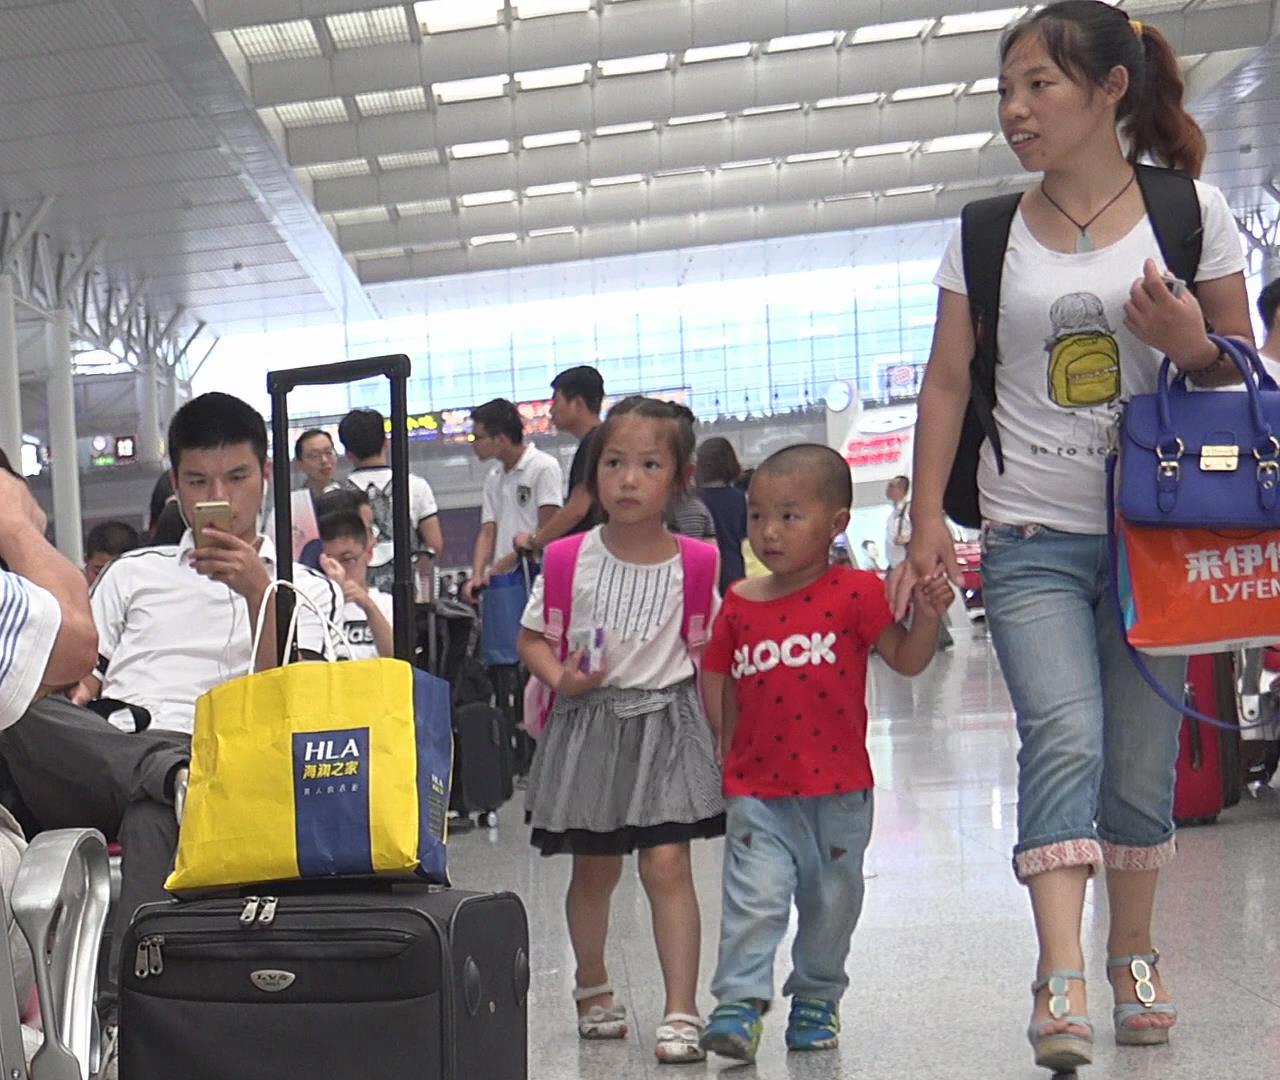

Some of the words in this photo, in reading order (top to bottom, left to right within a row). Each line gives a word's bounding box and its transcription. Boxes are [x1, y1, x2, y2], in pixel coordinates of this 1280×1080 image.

[305, 738, 360, 761] HLA
[302, 760, 359, 780] 海澜之家
